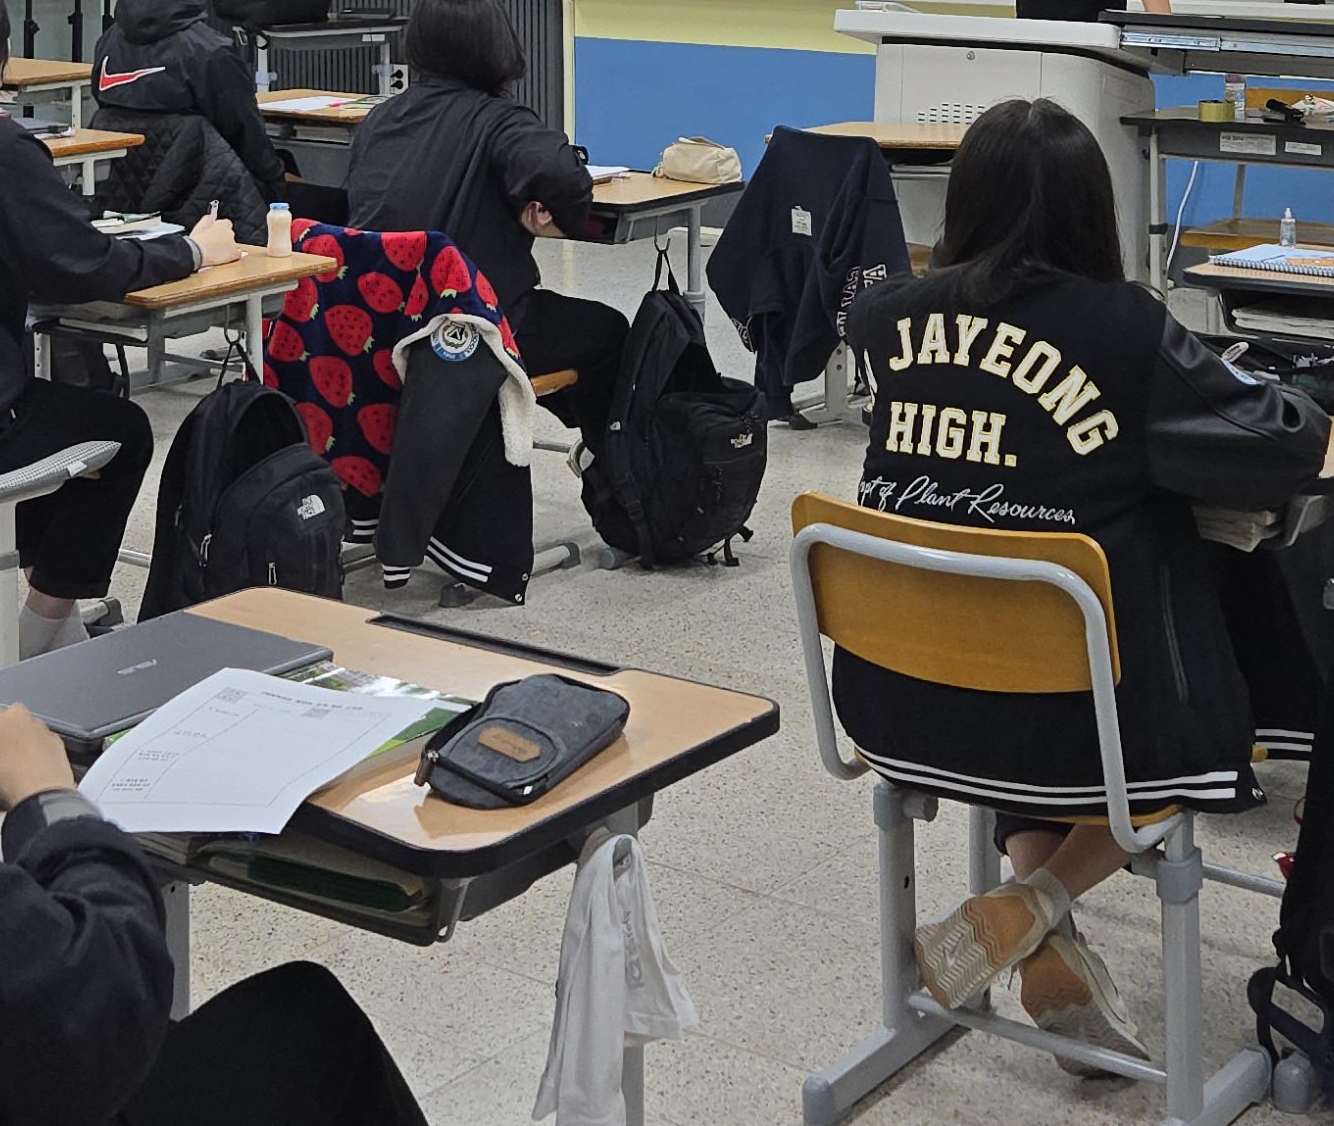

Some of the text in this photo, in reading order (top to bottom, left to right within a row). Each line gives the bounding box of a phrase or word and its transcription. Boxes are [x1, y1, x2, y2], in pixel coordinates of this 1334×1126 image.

[889, 313, 1119, 456] JAYEONG
[885, 401, 1017, 467] HIGH.
[895, 475, 972, 512] Plant
[967, 483, 1076, 525] Resources
